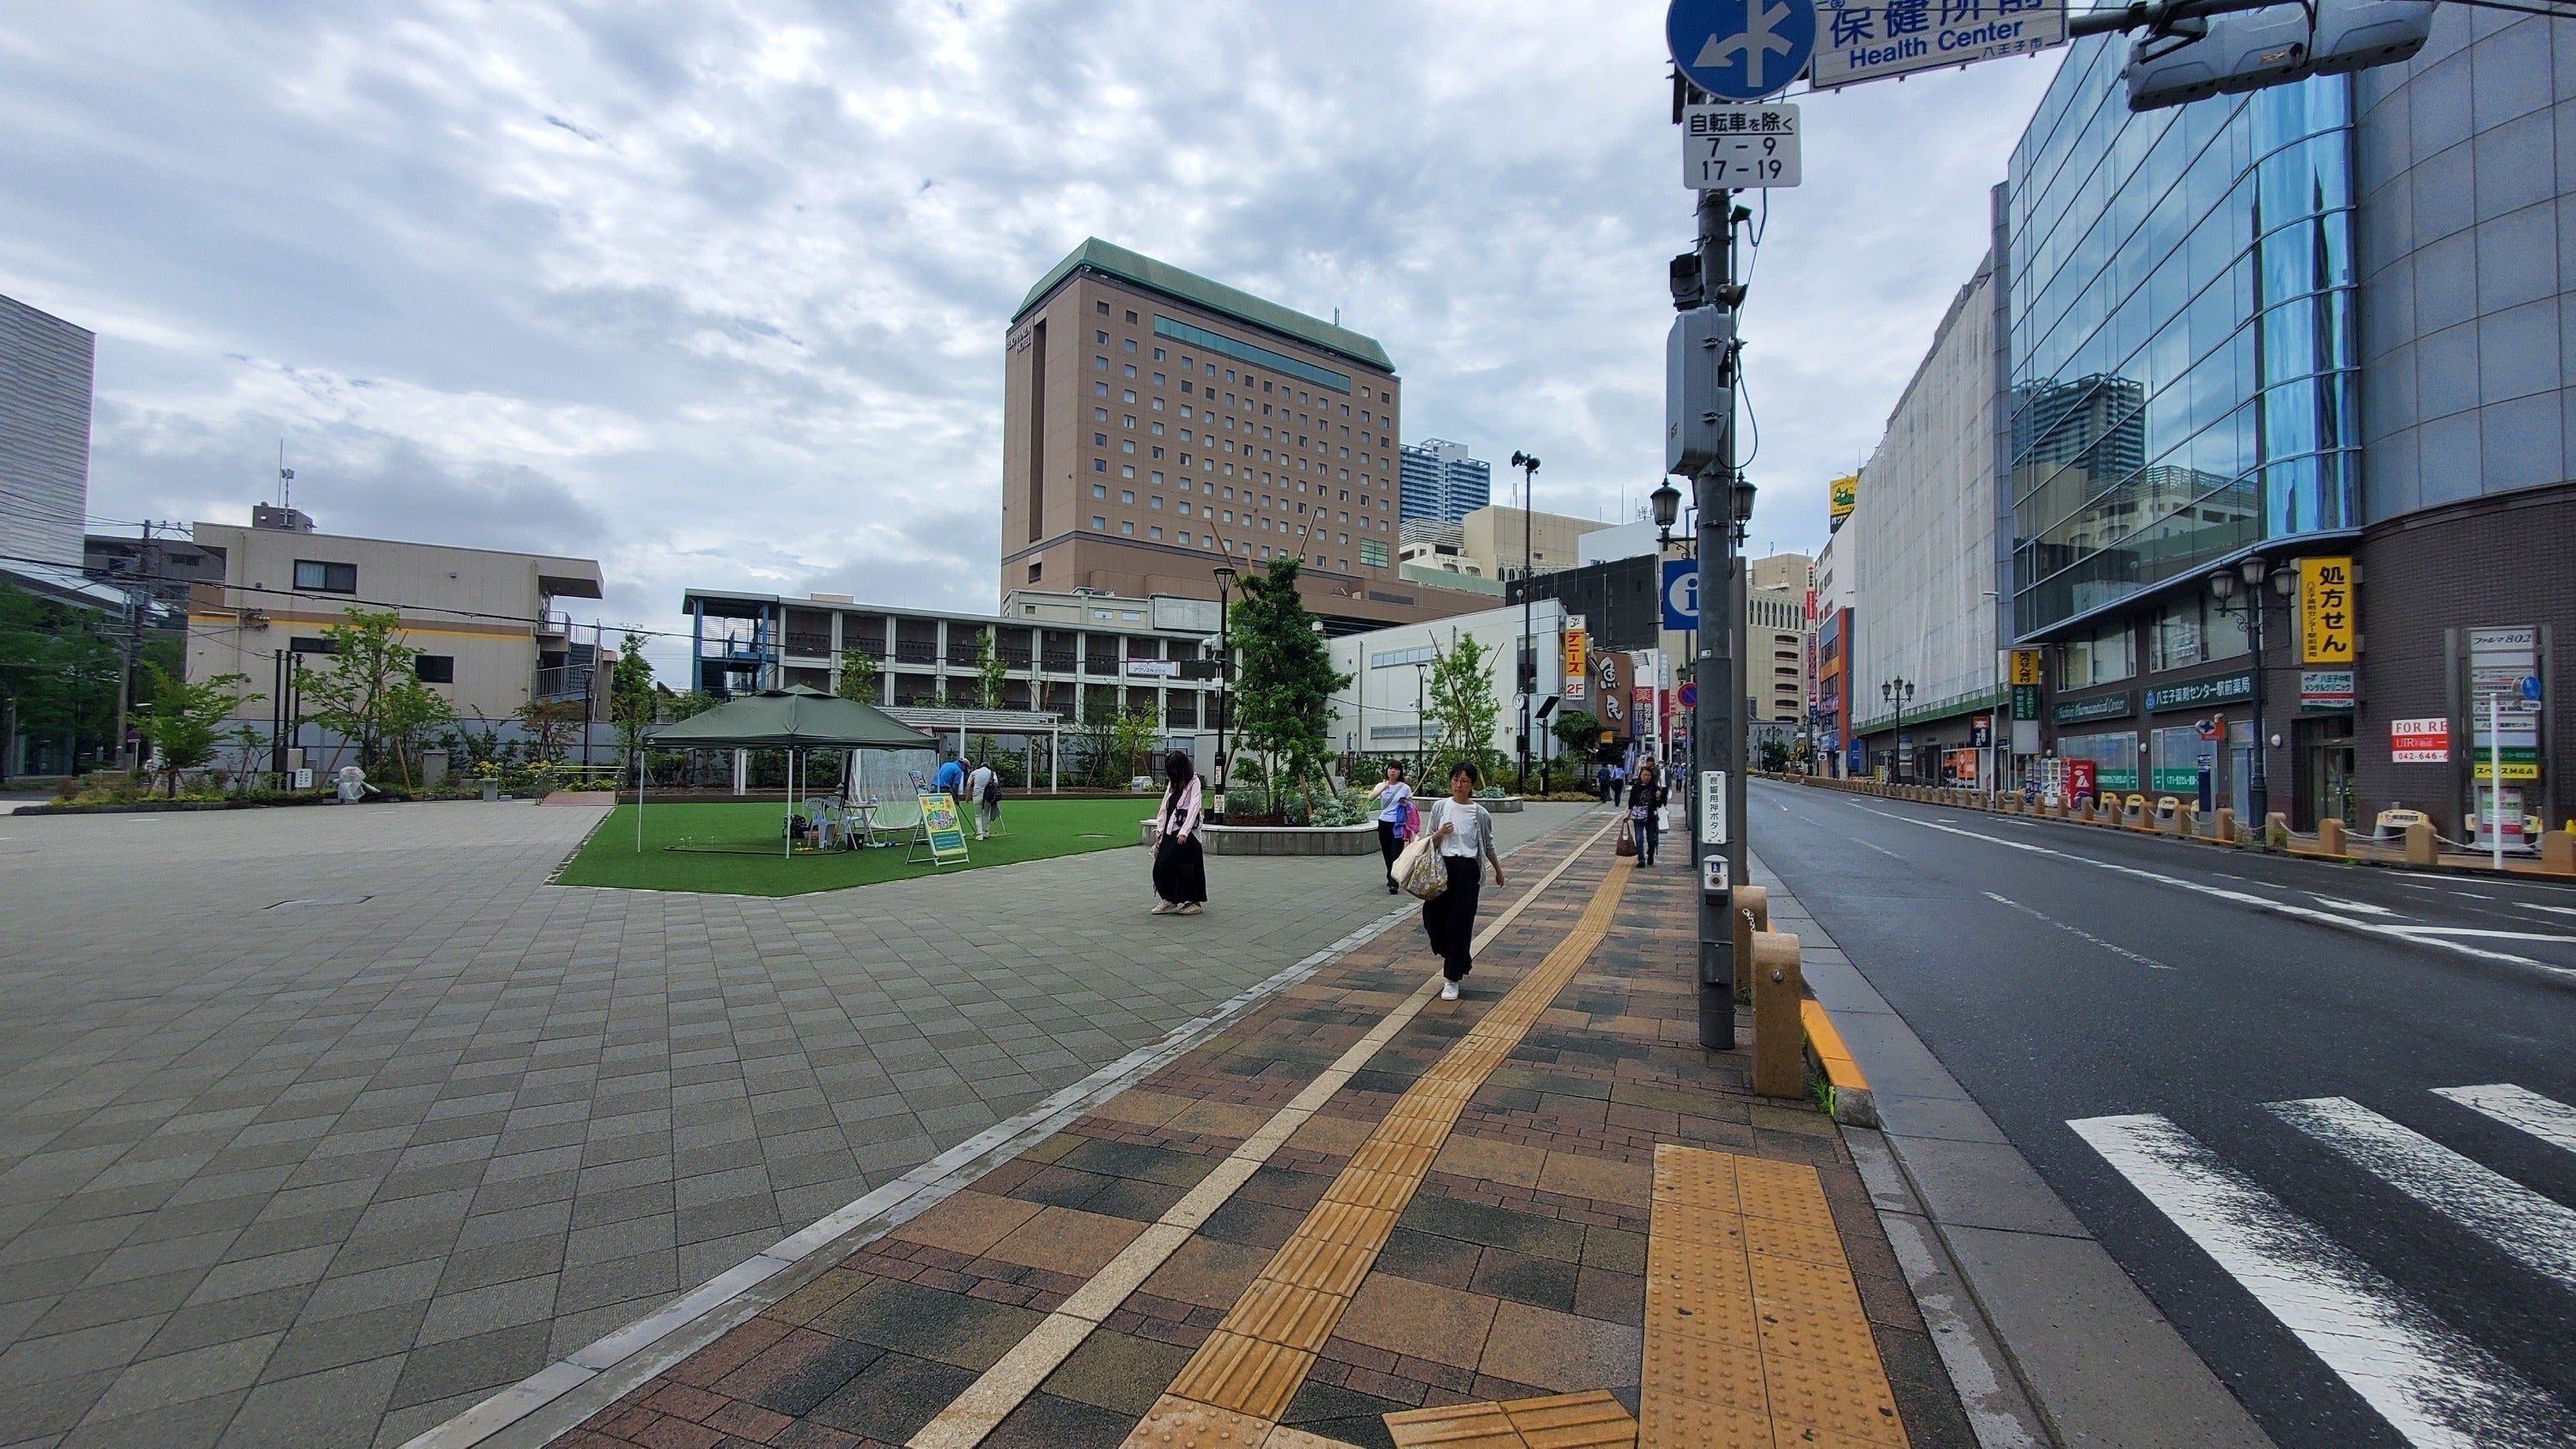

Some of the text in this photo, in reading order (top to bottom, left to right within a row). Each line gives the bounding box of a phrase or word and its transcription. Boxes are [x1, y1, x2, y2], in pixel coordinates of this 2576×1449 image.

[1850, 19, 2024, 69] Health Center
[1982, 37, 2044, 58] 八王子市
[1691, 113, 1793, 132] 自転車を除く
[2319, 566, 2347, 653] 処方せん
[1568, 631, 1584, 673] デニーズ
[1567, 684, 1583, 694] 2F
[1636, 688, 1652, 701] 薬
[2156, 676, 2251, 704] 八王子薬剤センター駅前薬局
[2396, 721, 2421, 733] FOR
[1710, 776, 1719, 839] 音響用押ボタン
